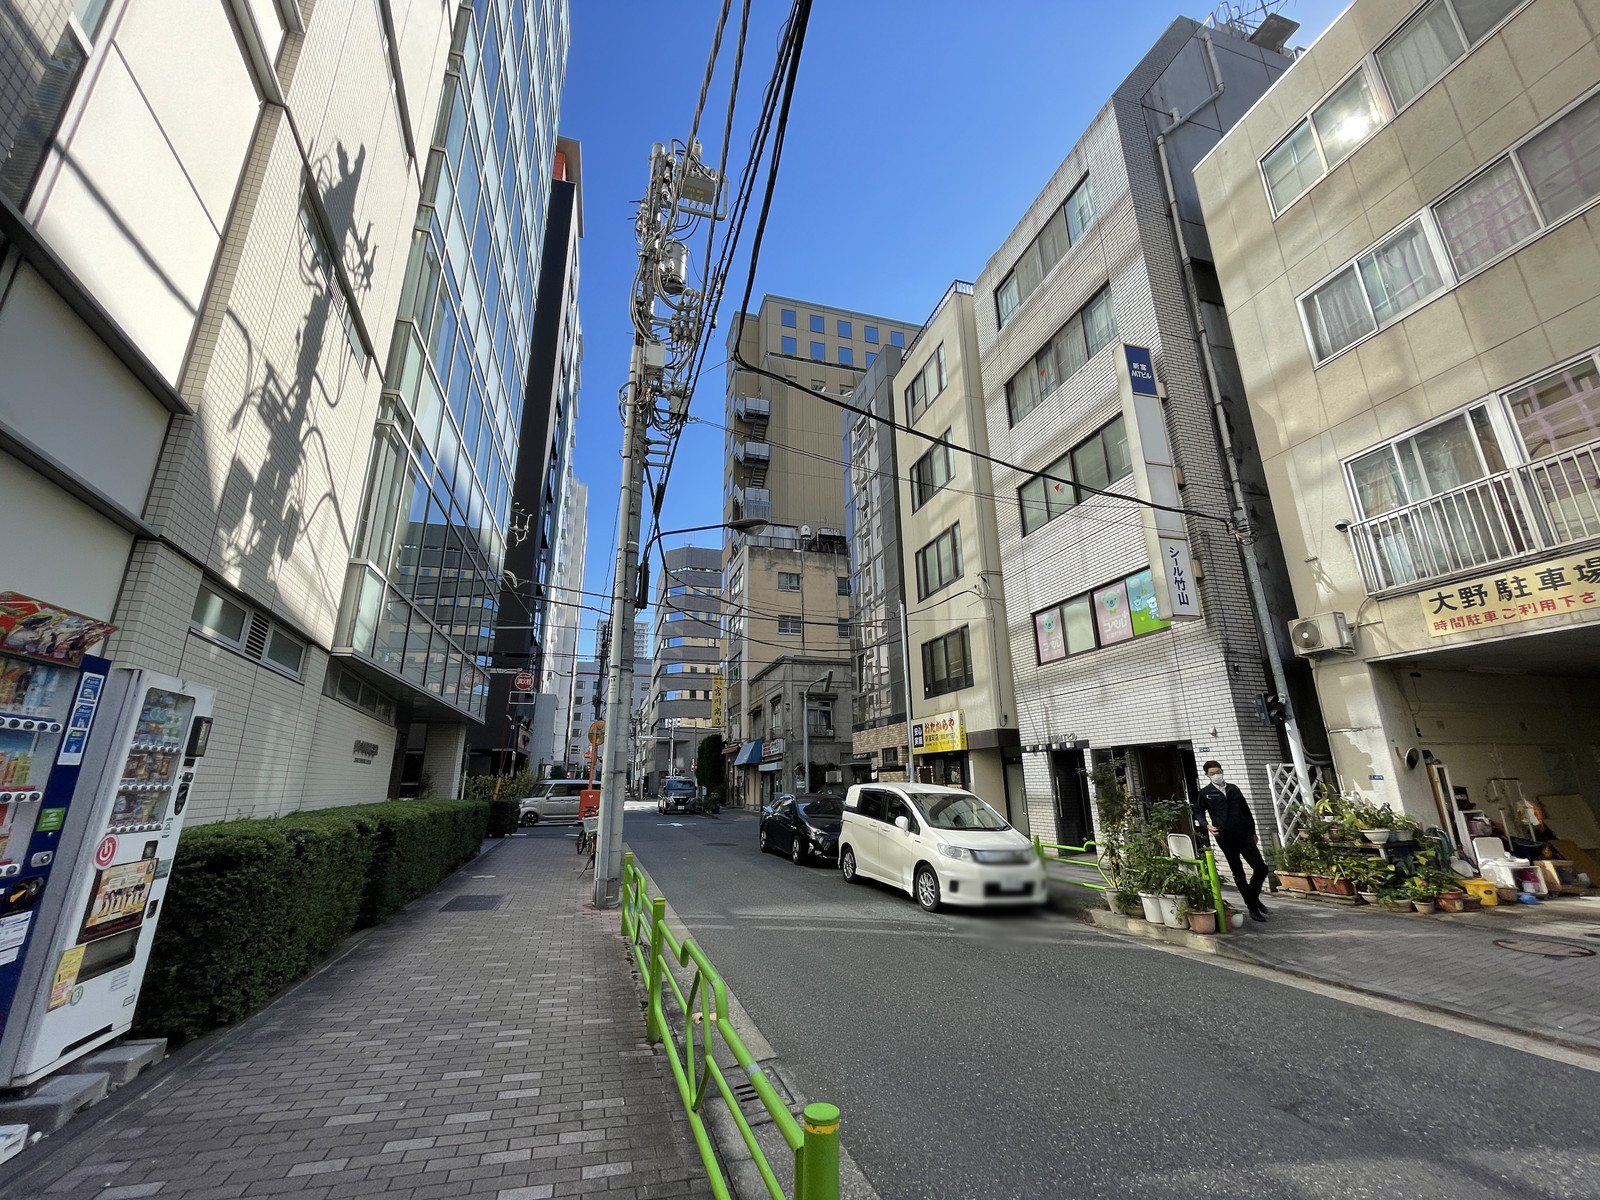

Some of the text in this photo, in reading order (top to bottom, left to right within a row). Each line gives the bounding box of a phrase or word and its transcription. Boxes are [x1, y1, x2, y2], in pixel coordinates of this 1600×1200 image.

[1131, 370, 1152, 379] MTビル
[1169, 546, 1190, 606] シール竹山
[1429, 557, 1600, 614] 大野駐車場
[1434, 592, 1597, 631] 時間駐車ご利用下さ
[714, 686, 722, 726] 宮川商店
[925, 718, 954, 733] おたからや
